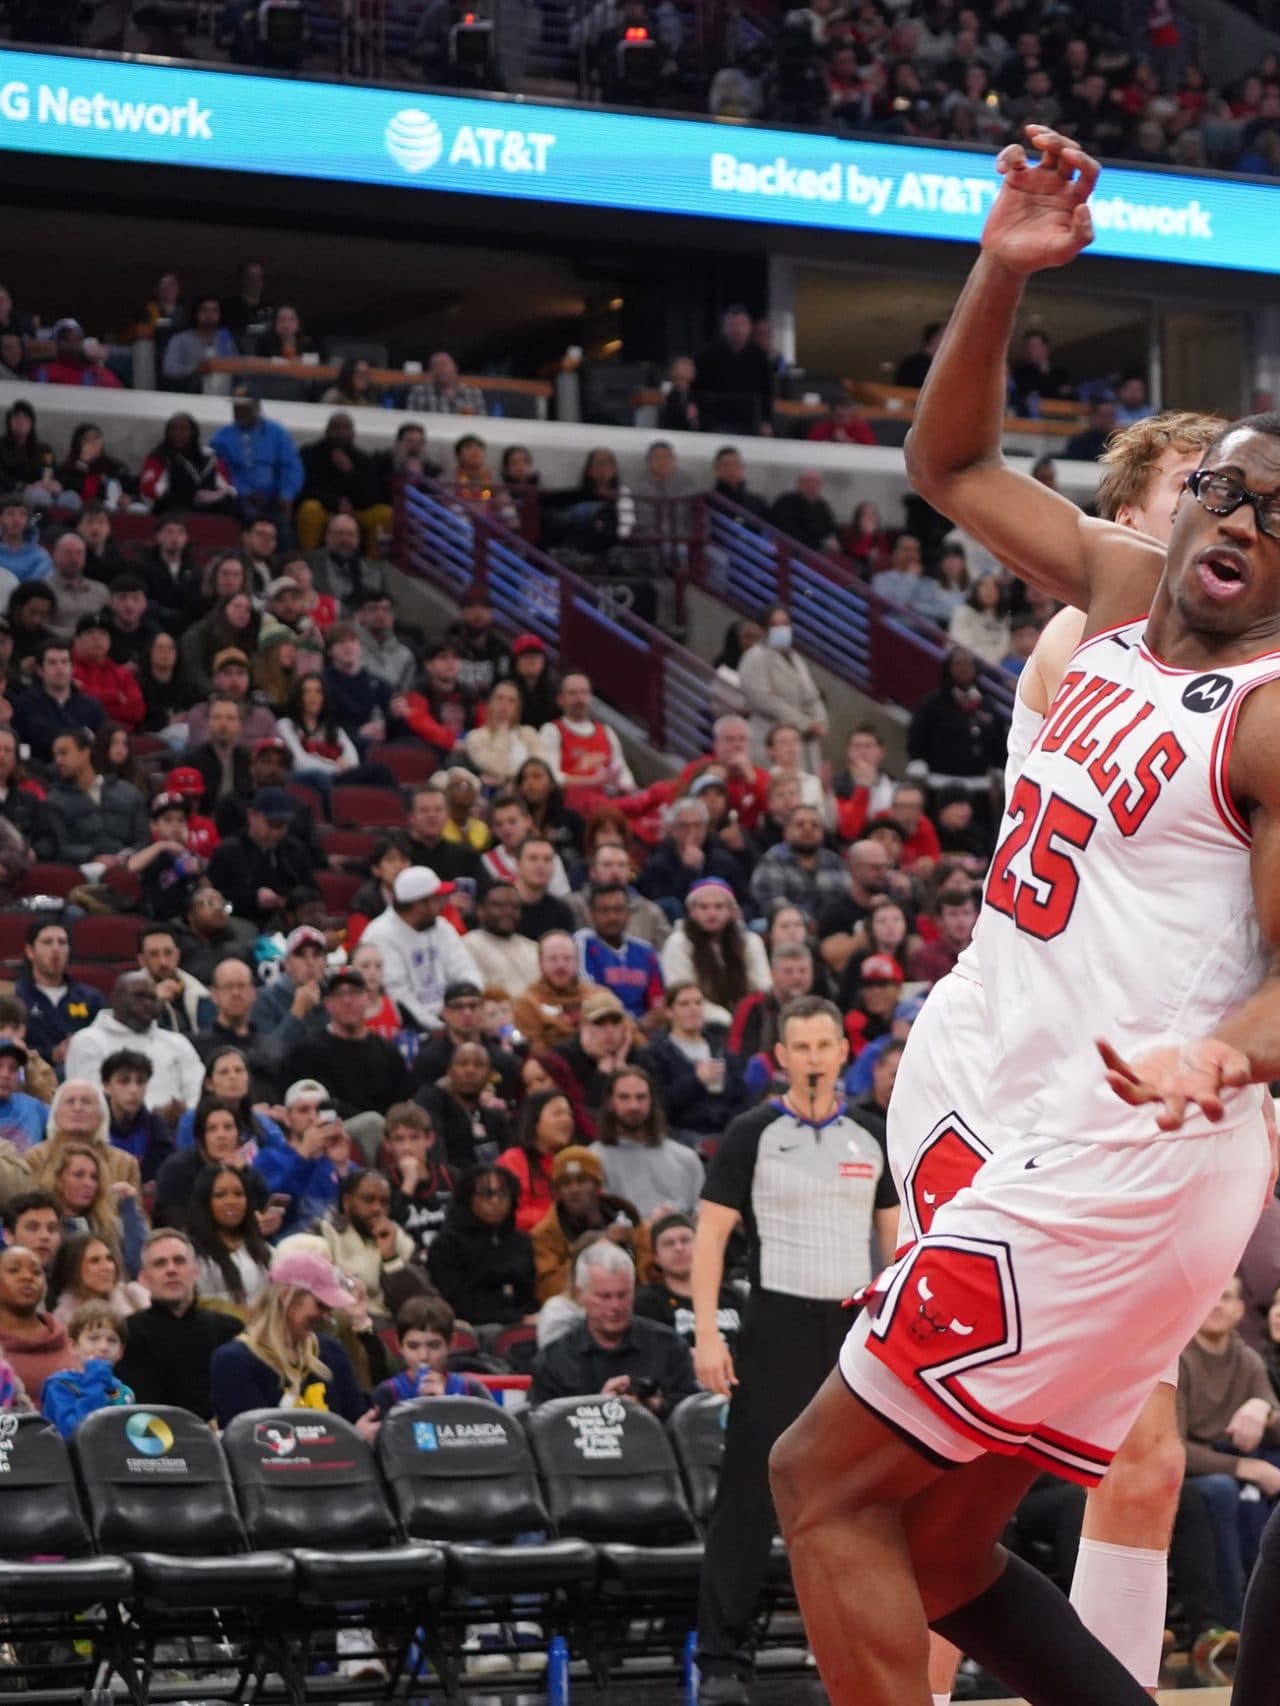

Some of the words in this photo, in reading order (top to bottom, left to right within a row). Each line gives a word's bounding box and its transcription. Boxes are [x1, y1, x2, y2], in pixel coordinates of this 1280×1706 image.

[38, 84, 213, 139] Network
[449, 124, 556, 173] AT&T
[710, 152, 842, 201] Backed
[846, 164, 892, 216] by
[1086, 196, 1213, 238] etwork
[984, 773, 1098, 943] 25
